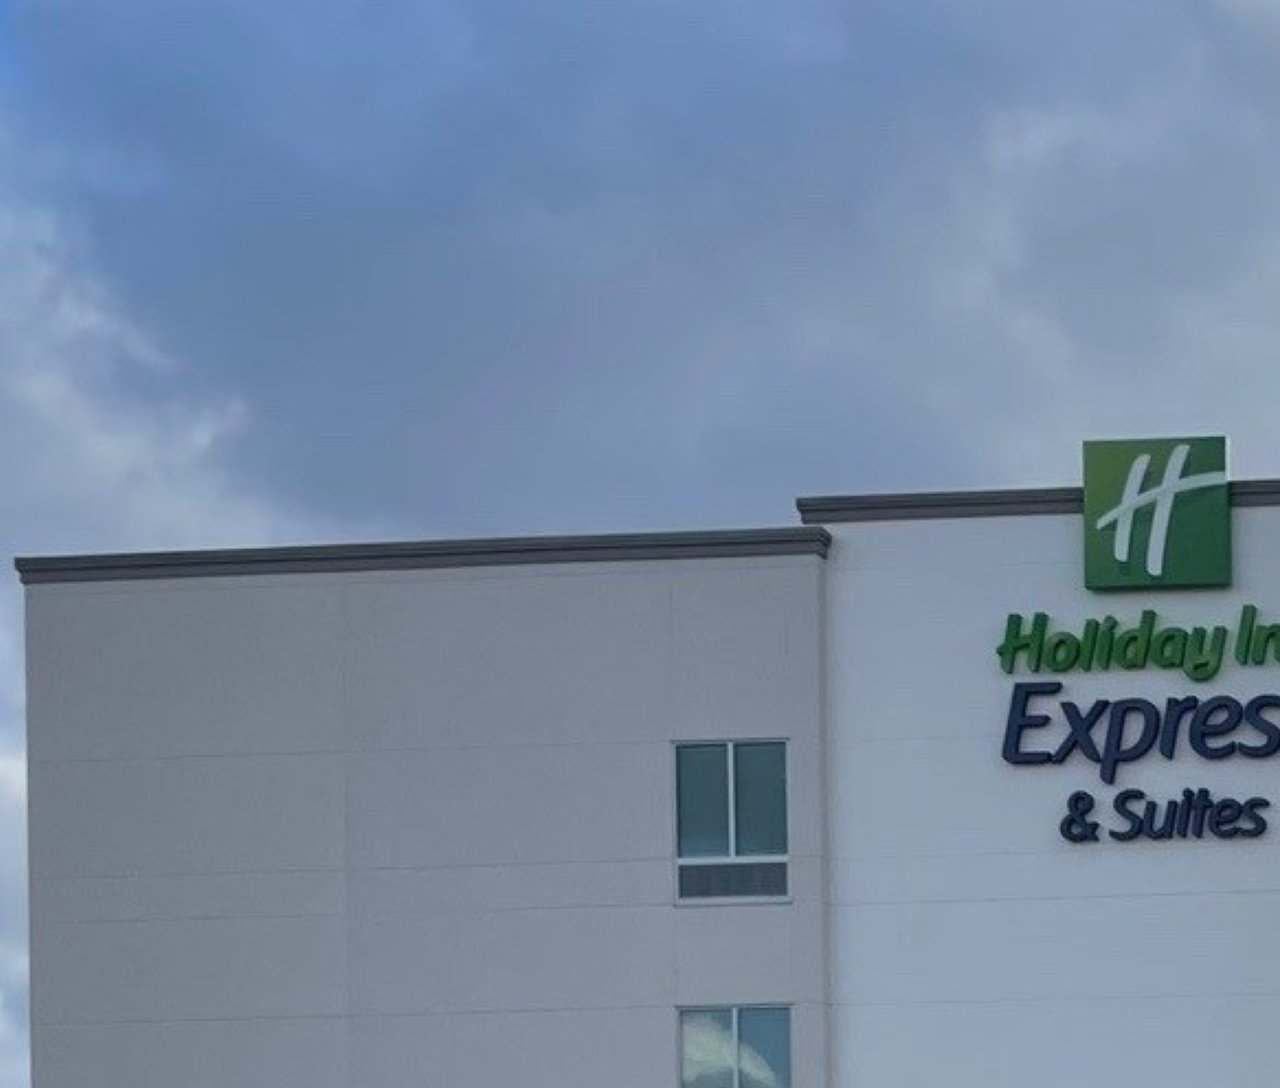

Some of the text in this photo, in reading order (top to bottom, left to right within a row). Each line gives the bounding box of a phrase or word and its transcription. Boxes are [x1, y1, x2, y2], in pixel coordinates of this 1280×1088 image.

[996, 609, 1228, 683] Holiday
[1060, 788, 1271, 843] & Suites
